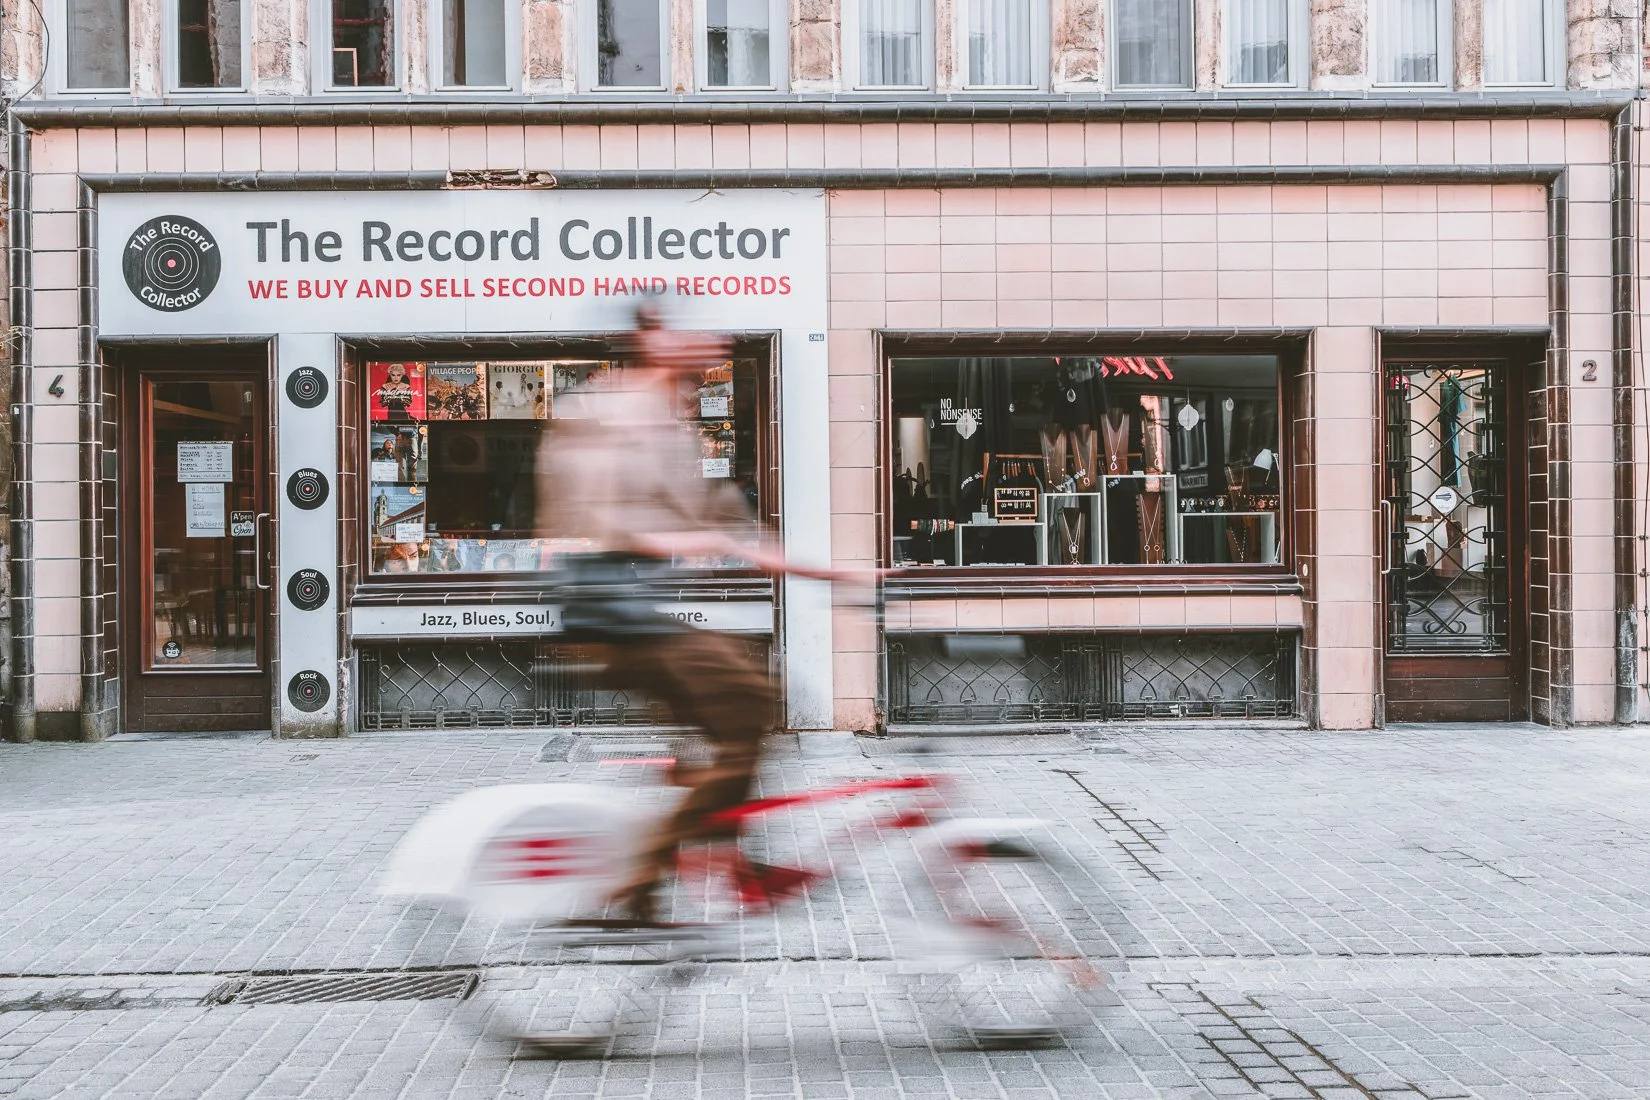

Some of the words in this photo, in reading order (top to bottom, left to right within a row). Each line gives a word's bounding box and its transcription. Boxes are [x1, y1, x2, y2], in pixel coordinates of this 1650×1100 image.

[129, 228, 158, 251] The
[160, 221, 215, 252] Record
[246, 219, 342, 262] The
[363, 217, 539, 262] Record
[559, 216, 790, 261] Collector
[140, 285, 202, 308] Collector
[248, 279, 288, 299] WE
[298, 279, 349, 299] BUY
[356, 279, 412, 298] AND
[420, 279, 476, 298] SELL
[482, 277, 586, 297] SECOND
[594, 277, 668, 296] HAND
[676, 275, 792, 296] RECORDS
[298, 369, 314, 377] Jazz
[494, 365, 544, 374] GIORGIO
[1582, 359, 1598, 382] 2
[48, 374, 65, 398] 4
[940, 397, 952, 410] NO
[940, 408, 983, 420] NONSENSE
[297, 471, 318, 479] Blues
[420, 612, 458, 629] Jazz,
[462, 611, 511, 628] Blues,
[515, 610, 555, 627] Soul,
[300, 672, 318, 680] Rock
